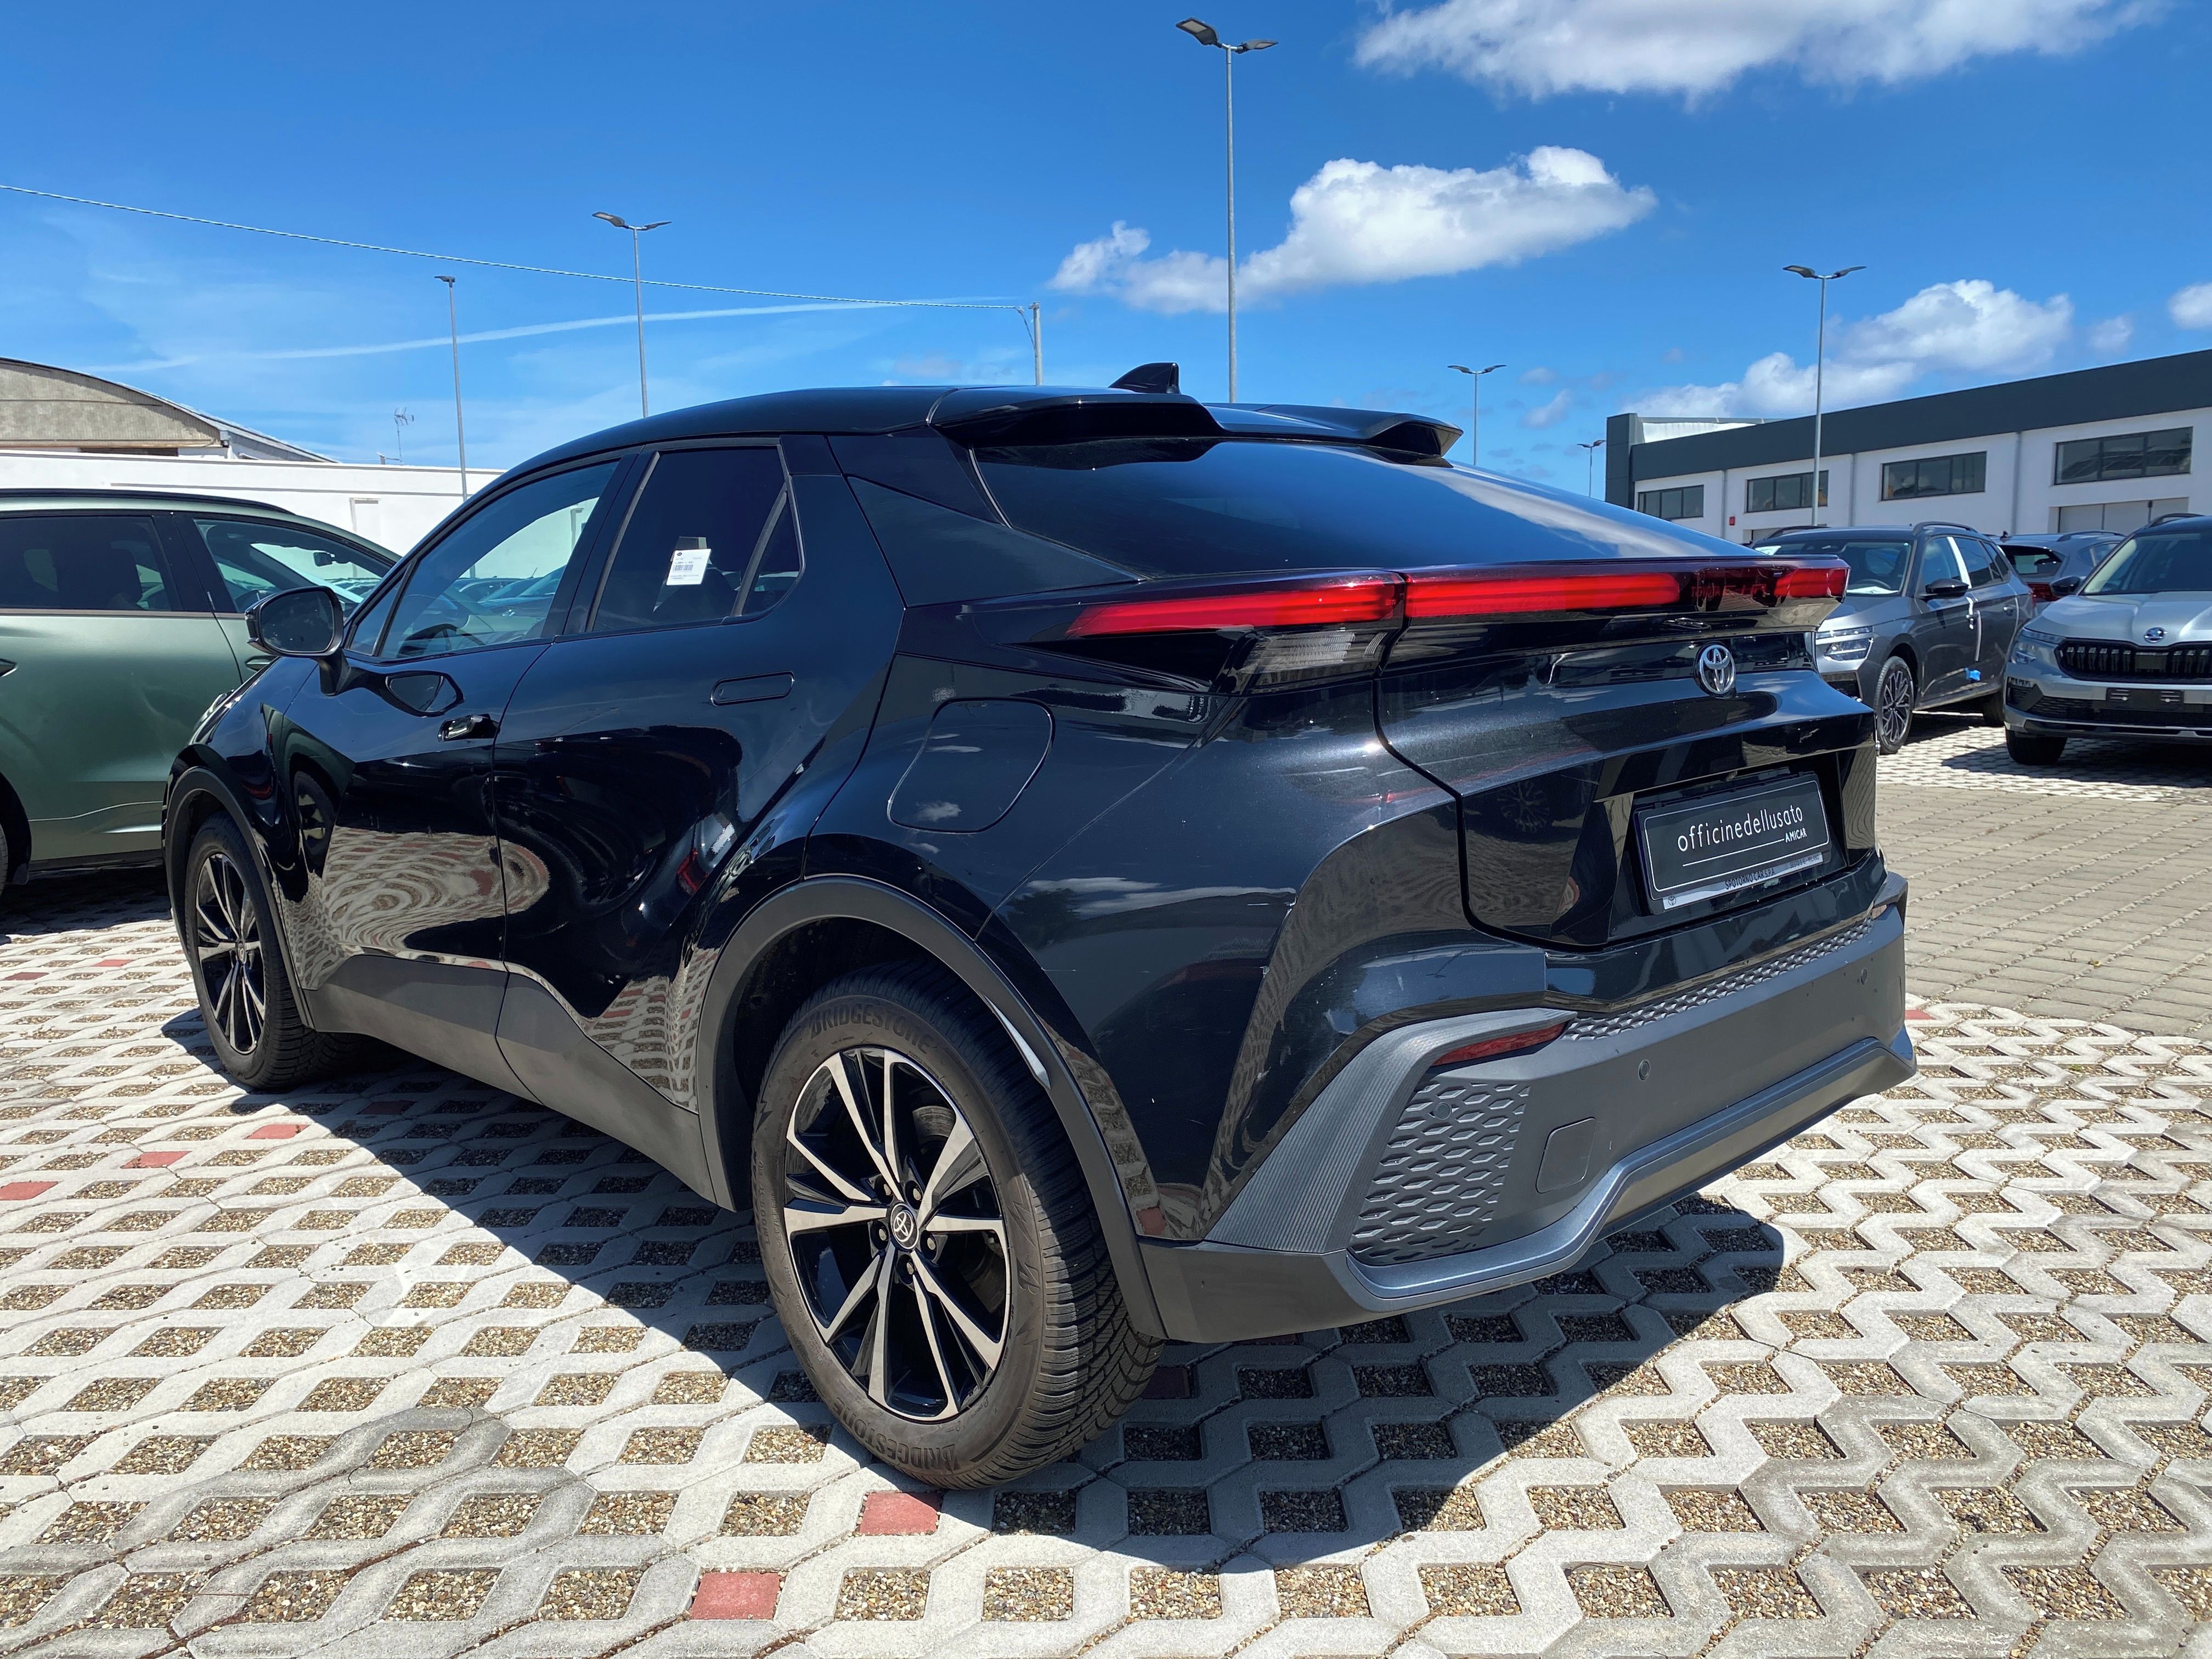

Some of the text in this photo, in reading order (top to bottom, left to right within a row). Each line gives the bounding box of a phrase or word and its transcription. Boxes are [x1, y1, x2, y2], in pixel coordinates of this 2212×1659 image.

[1678, 805, 1803, 851] officinedellusato
[1785, 828, 1807, 843] AMICAR
[1725, 873, 1753, 890] SPOTORNO
[1754, 870, 1765, 881] CAR
[809, 1003, 937, 1055] BRIDGESTONE
[832, 1397, 961, 1472] BRIDGESTONE
